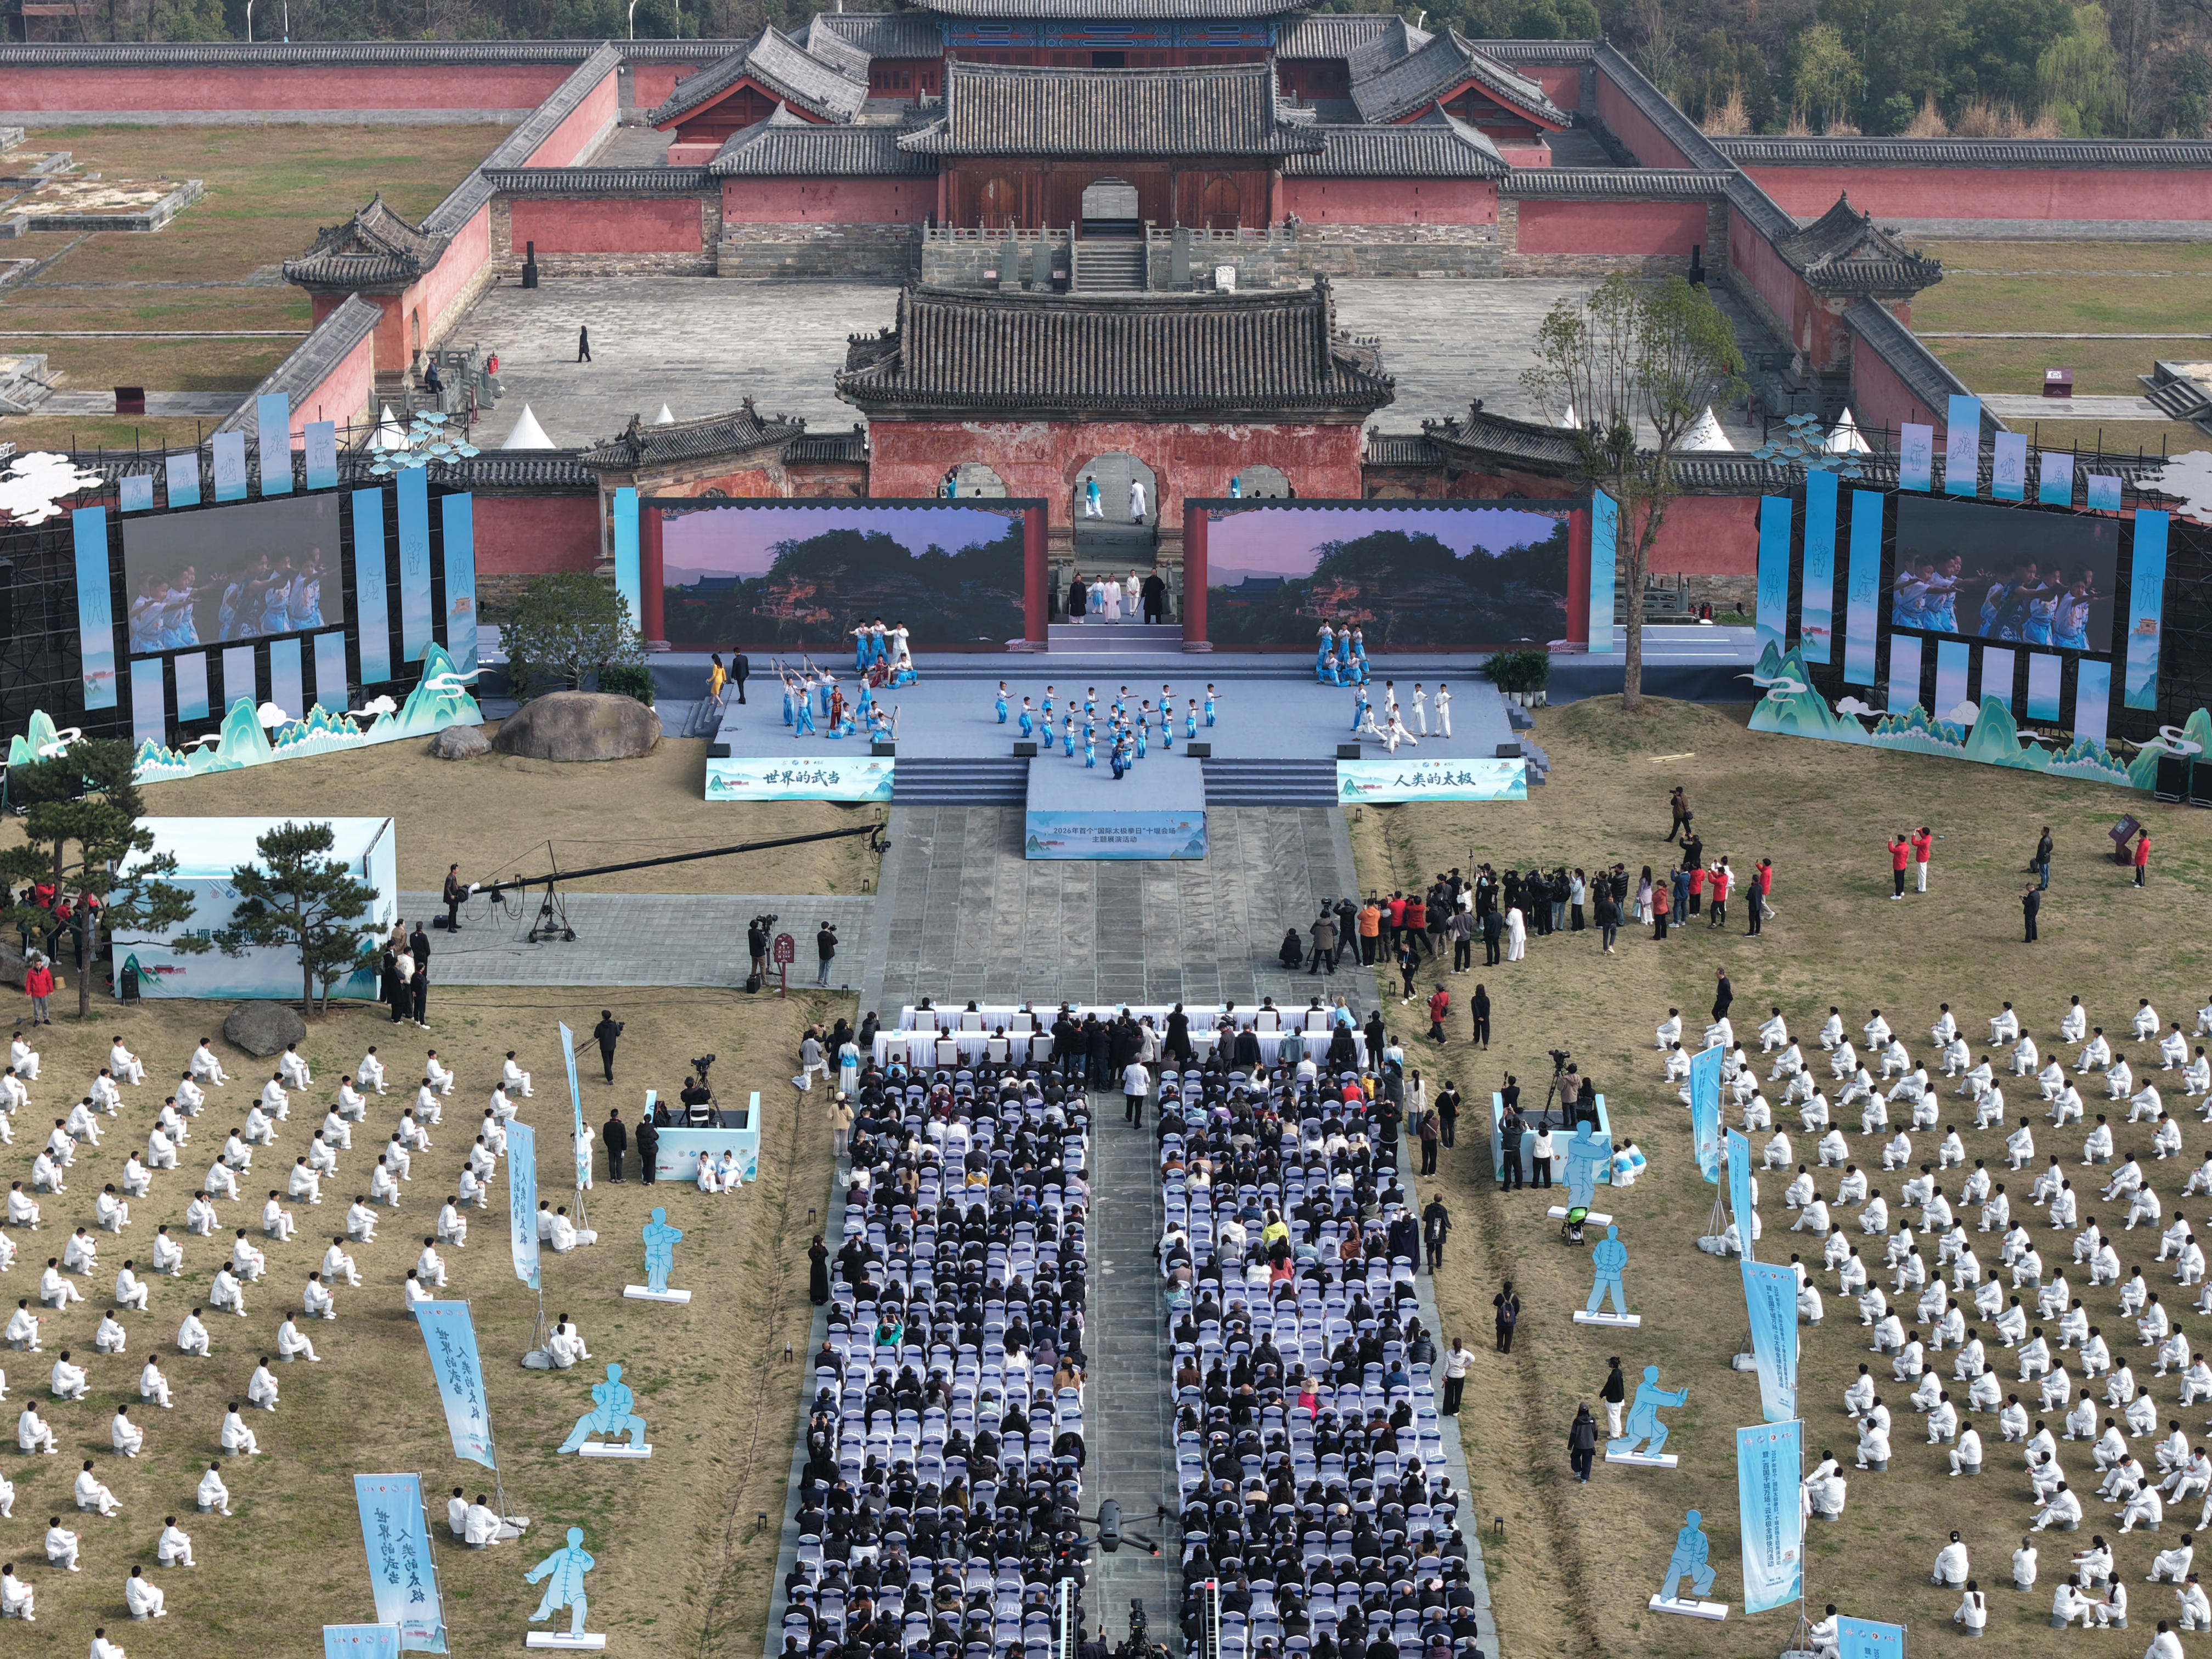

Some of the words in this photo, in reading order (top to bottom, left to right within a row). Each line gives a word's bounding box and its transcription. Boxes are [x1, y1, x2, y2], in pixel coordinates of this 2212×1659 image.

[763, 769, 840, 789] 世界的武当
[1393, 770, 1476, 787] 人类的太极
